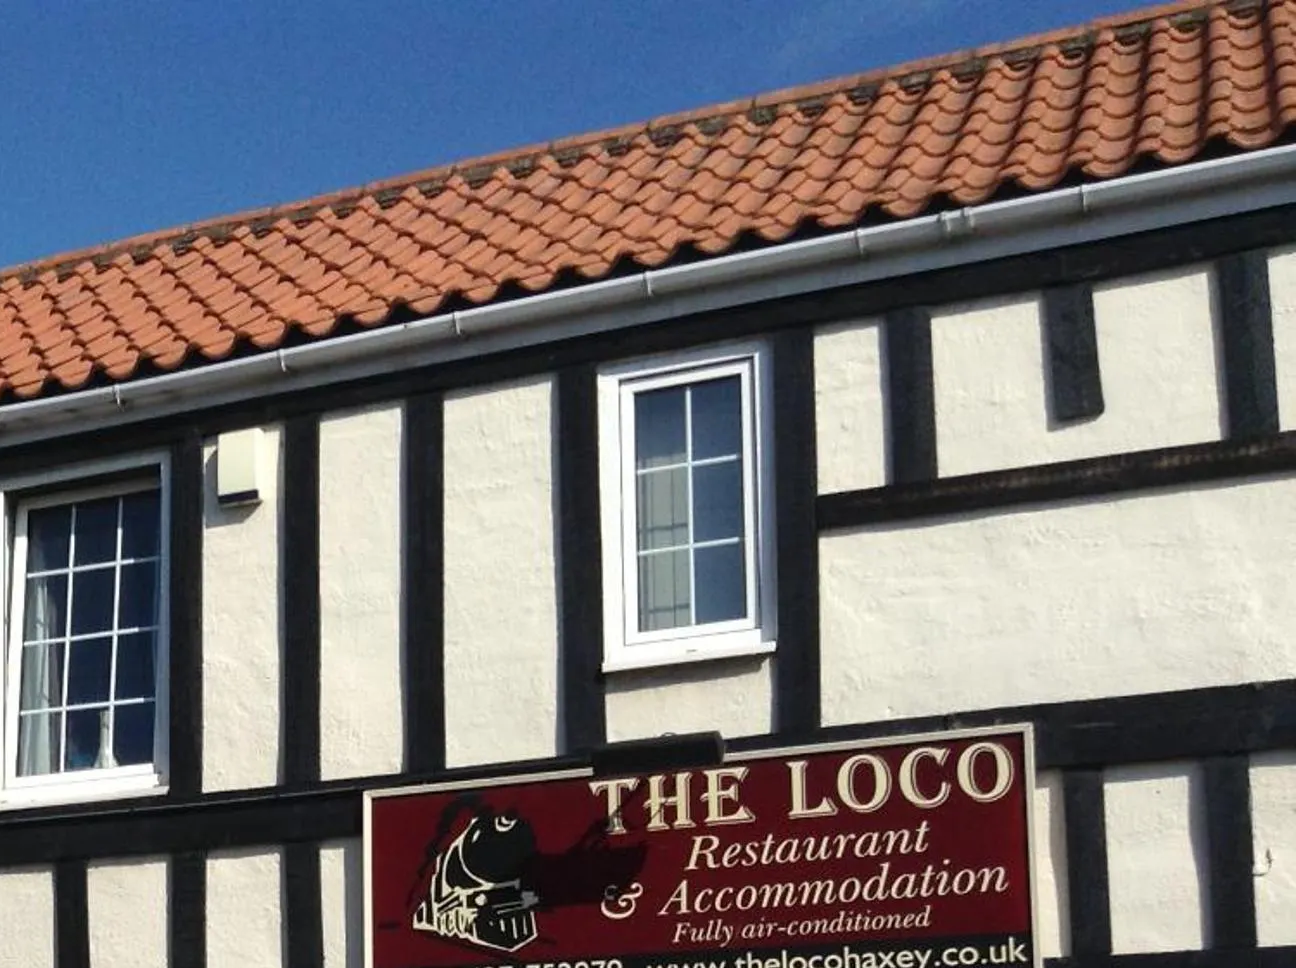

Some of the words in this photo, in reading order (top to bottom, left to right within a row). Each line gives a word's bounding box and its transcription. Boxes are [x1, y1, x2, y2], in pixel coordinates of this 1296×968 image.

[588, 765, 756, 836] THE
[785, 741, 1015, 820] LOCO
[684, 820, 931, 872] Restaurant
[600, 882, 644, 919] &
[657, 859, 1010, 917] Accommodation
[672, 917, 735, 948] Fully
[741, 905, 932, 940] air-conditioned
